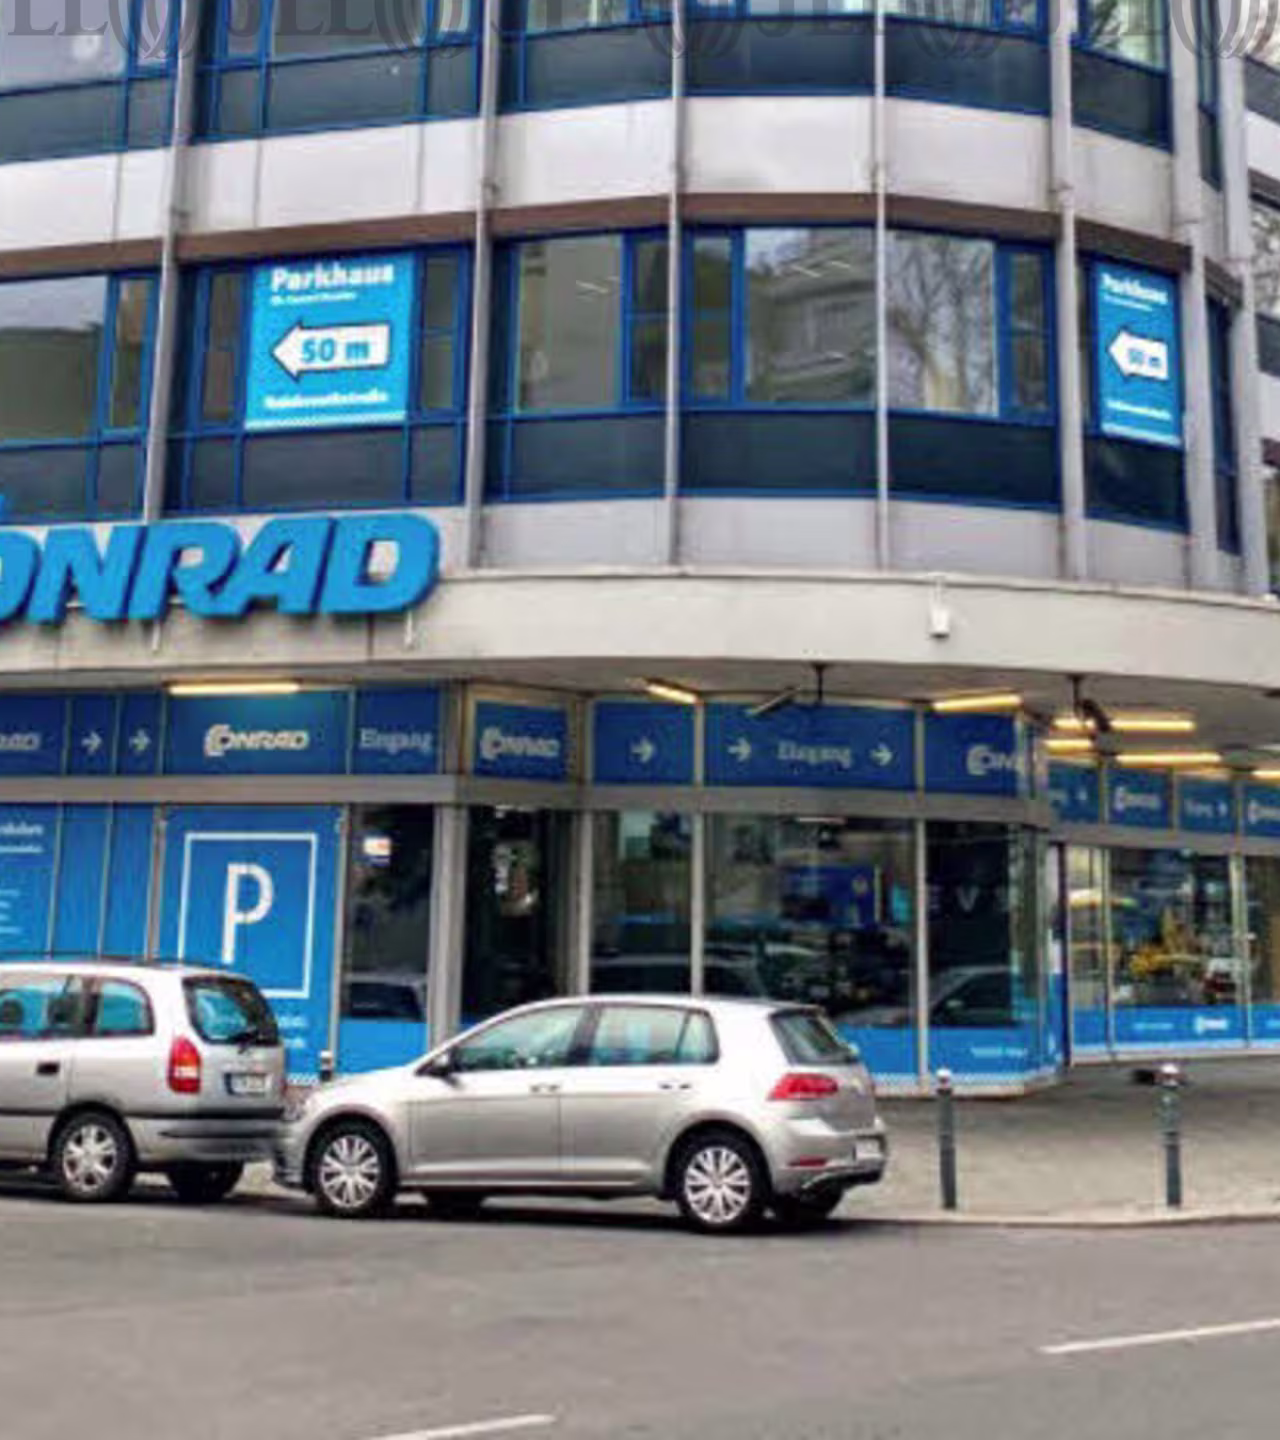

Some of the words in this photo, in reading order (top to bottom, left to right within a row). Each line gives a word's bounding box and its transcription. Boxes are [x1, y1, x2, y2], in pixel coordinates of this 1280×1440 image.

[271, 262, 394, 292] Parkhaus
[300, 338, 335, 362] 50
[345, 341, 370, 359] m
[204, 724, 310, 756] CONRAD
[223, 862, 274, 964] P
